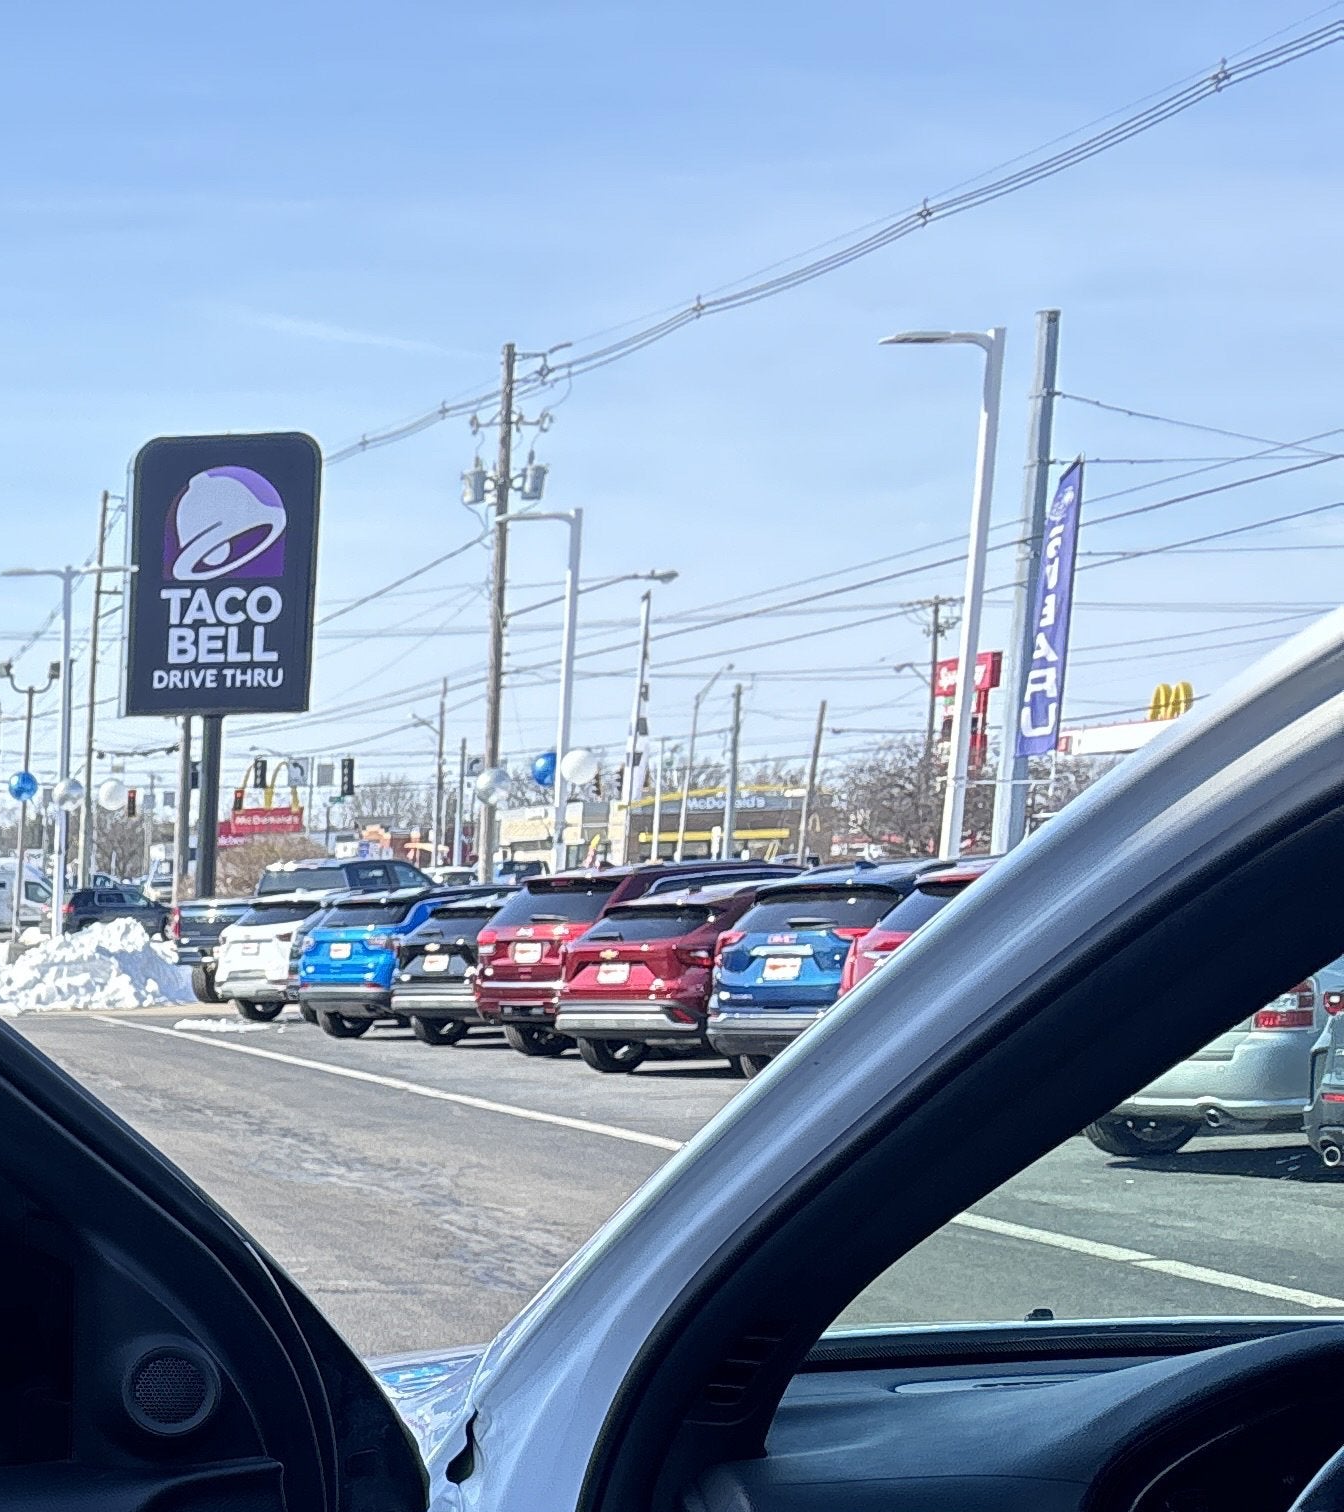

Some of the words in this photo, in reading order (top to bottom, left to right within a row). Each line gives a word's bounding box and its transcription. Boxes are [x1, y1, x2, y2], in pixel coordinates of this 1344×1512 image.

[160, 586, 283, 625] TACO
[167, 625, 279, 664] BELL
[152, 669, 218, 690] DRIVE
[222, 668, 284, 688] THRU
